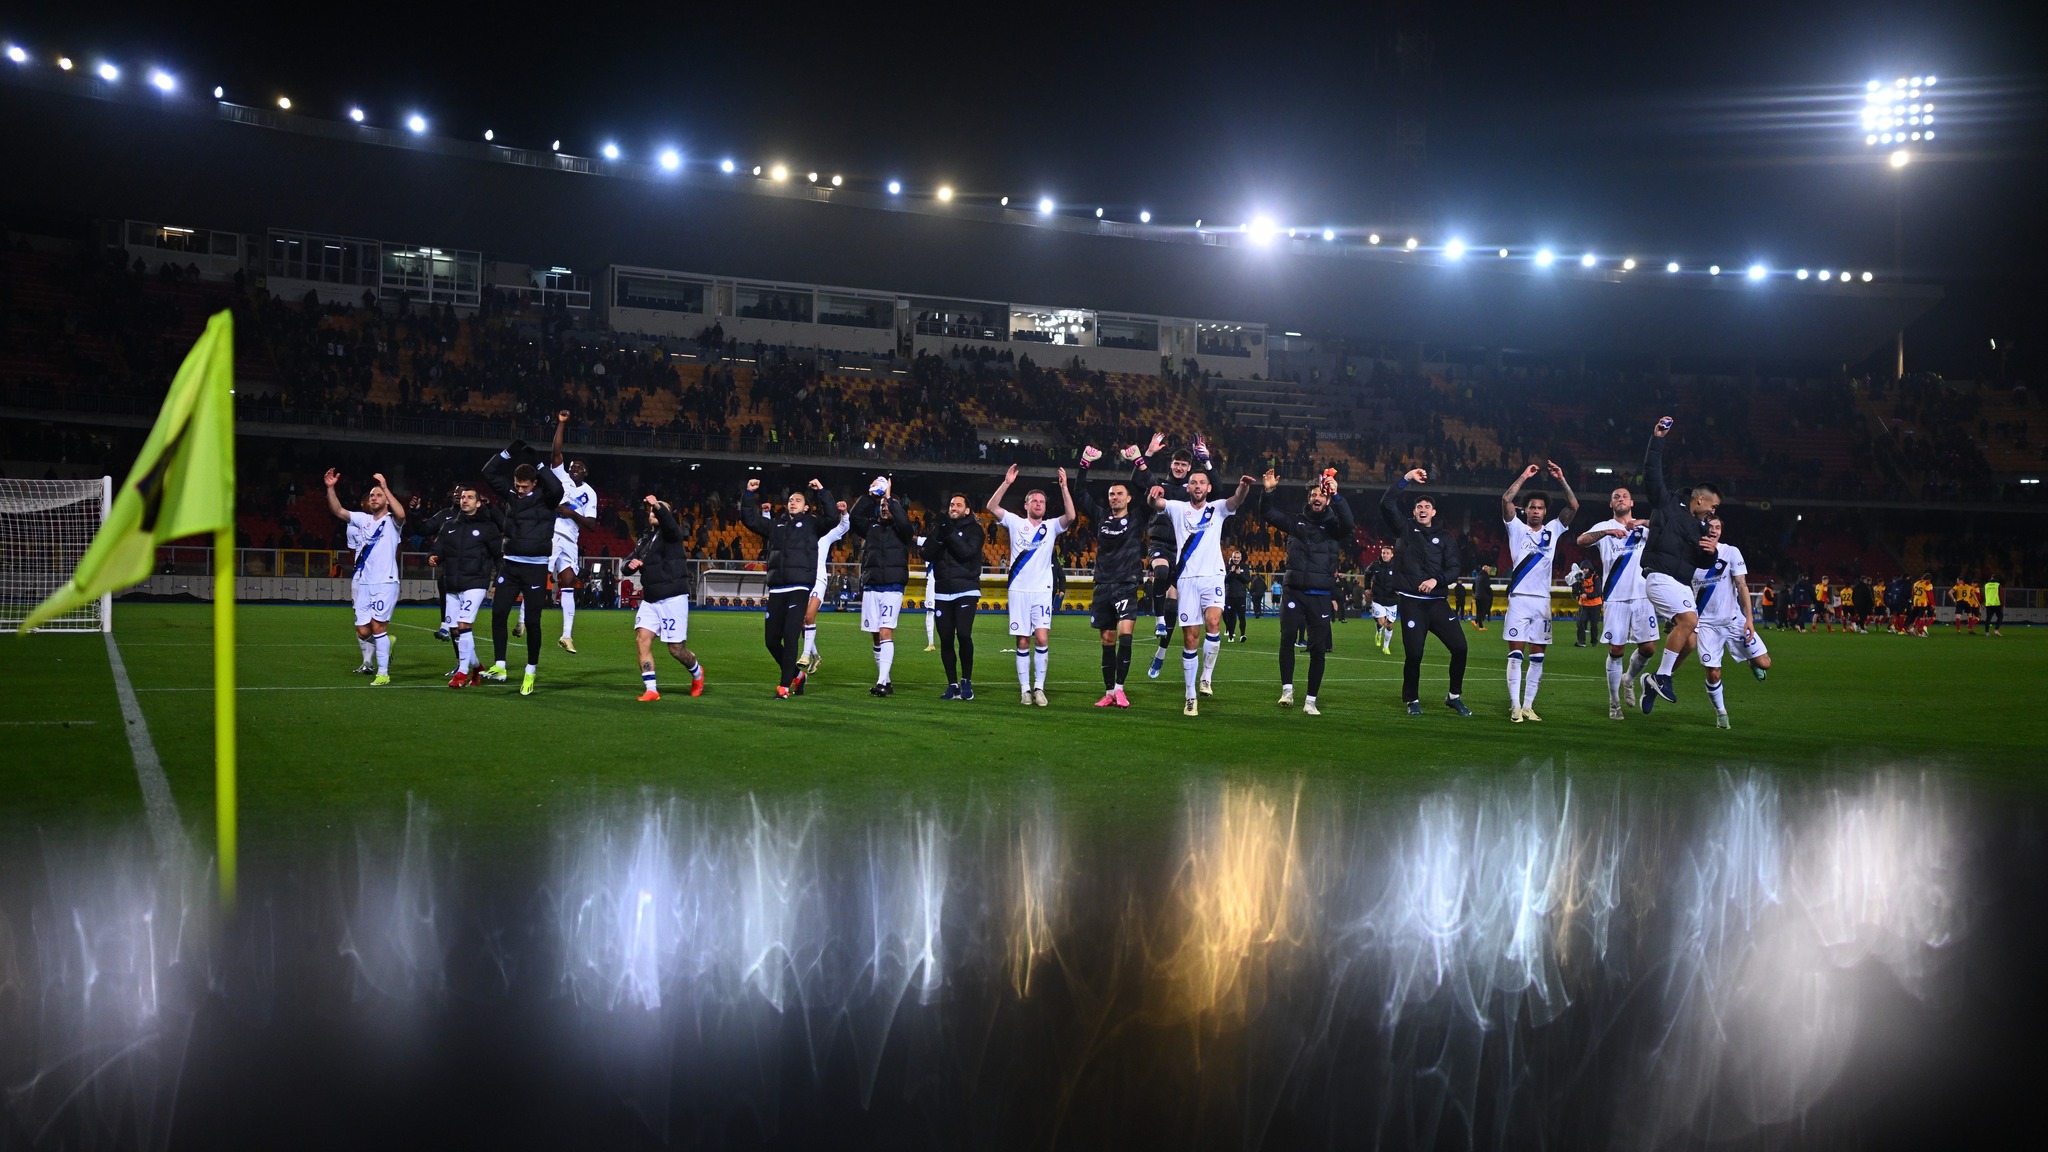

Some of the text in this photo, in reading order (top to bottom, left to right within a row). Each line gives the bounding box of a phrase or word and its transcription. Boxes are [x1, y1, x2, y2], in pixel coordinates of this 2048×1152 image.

[1215, 587, 1223, 597] 6
[1914, 586, 1923, 597] 25
[881, 605, 893, 617] 21
[1039, 605, 1051, 617] 14
[662, 618, 676, 631] 32
[1648, 616, 1656, 629] 8
